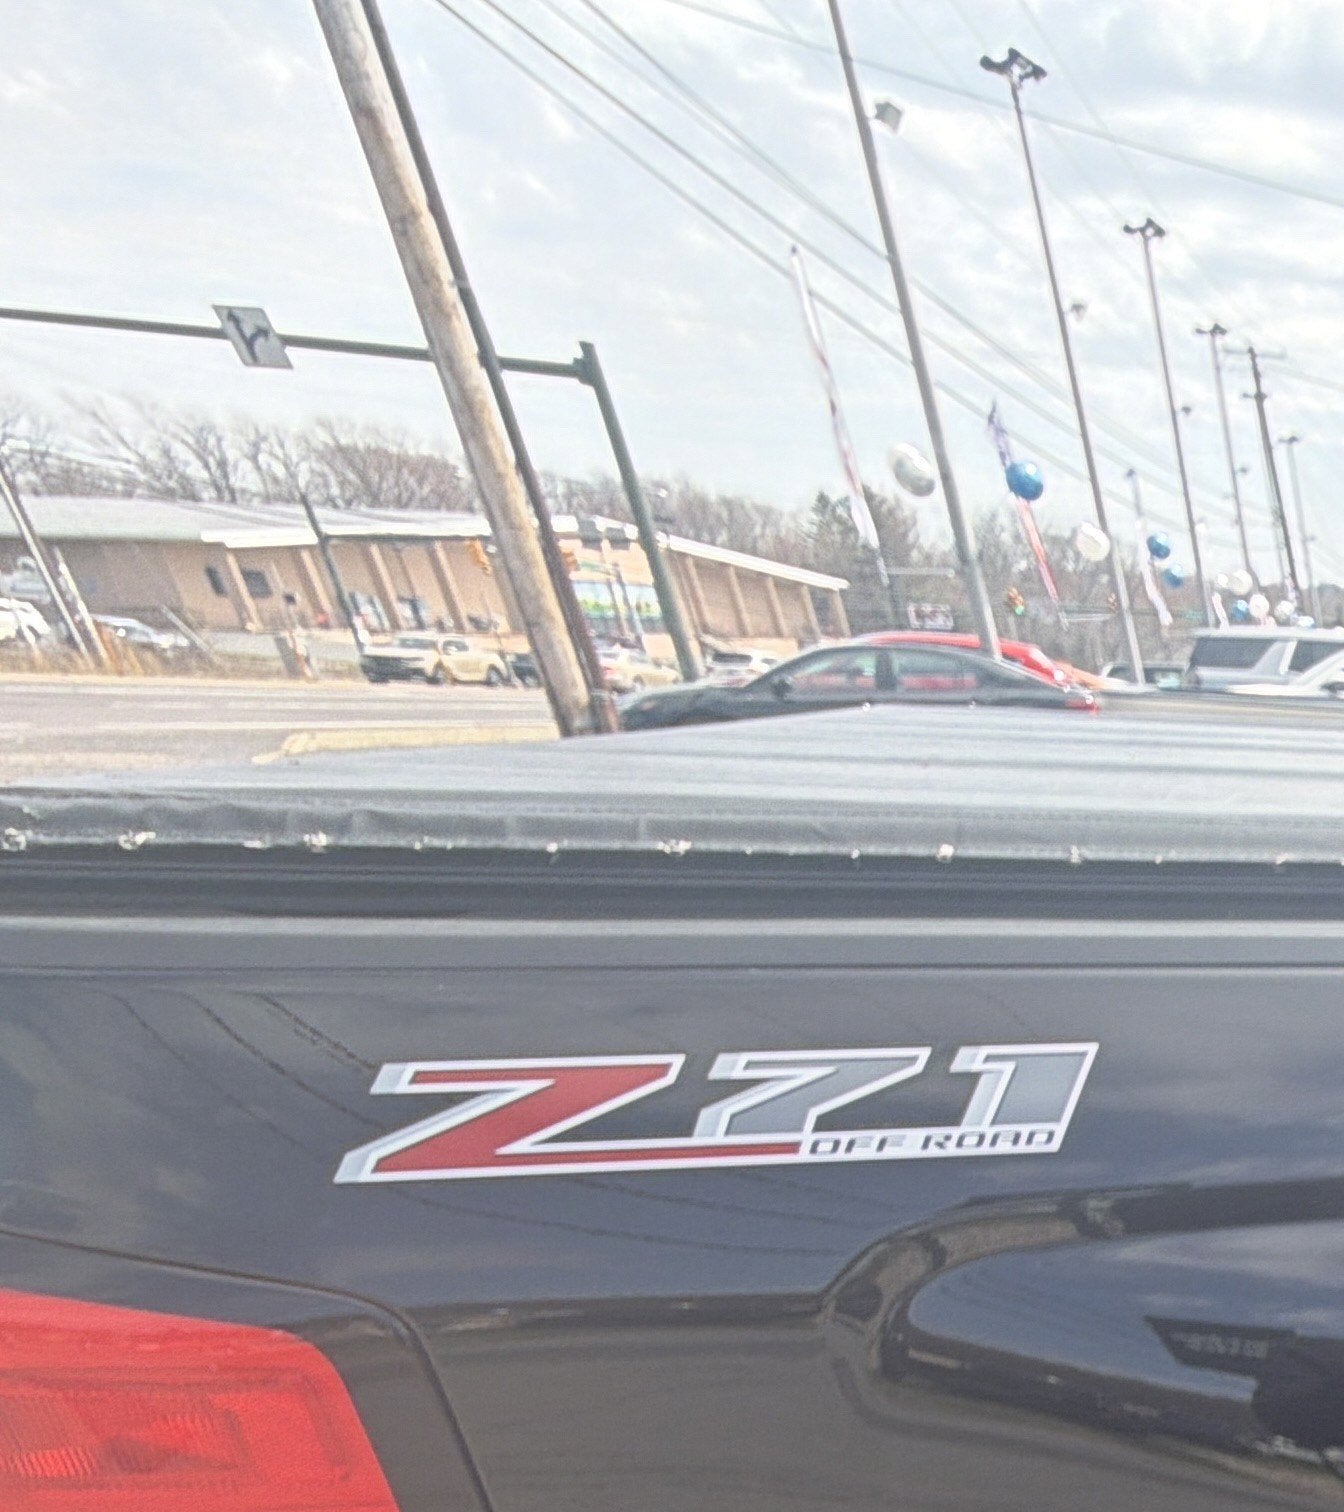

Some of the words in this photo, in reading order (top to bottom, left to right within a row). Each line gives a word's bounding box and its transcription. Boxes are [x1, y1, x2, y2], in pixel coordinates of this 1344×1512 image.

[335, 1043, 1098, 1183] Z71
[809, 1135, 906, 1154] OFF
[921, 1129, 1056, 1151] ROAD
